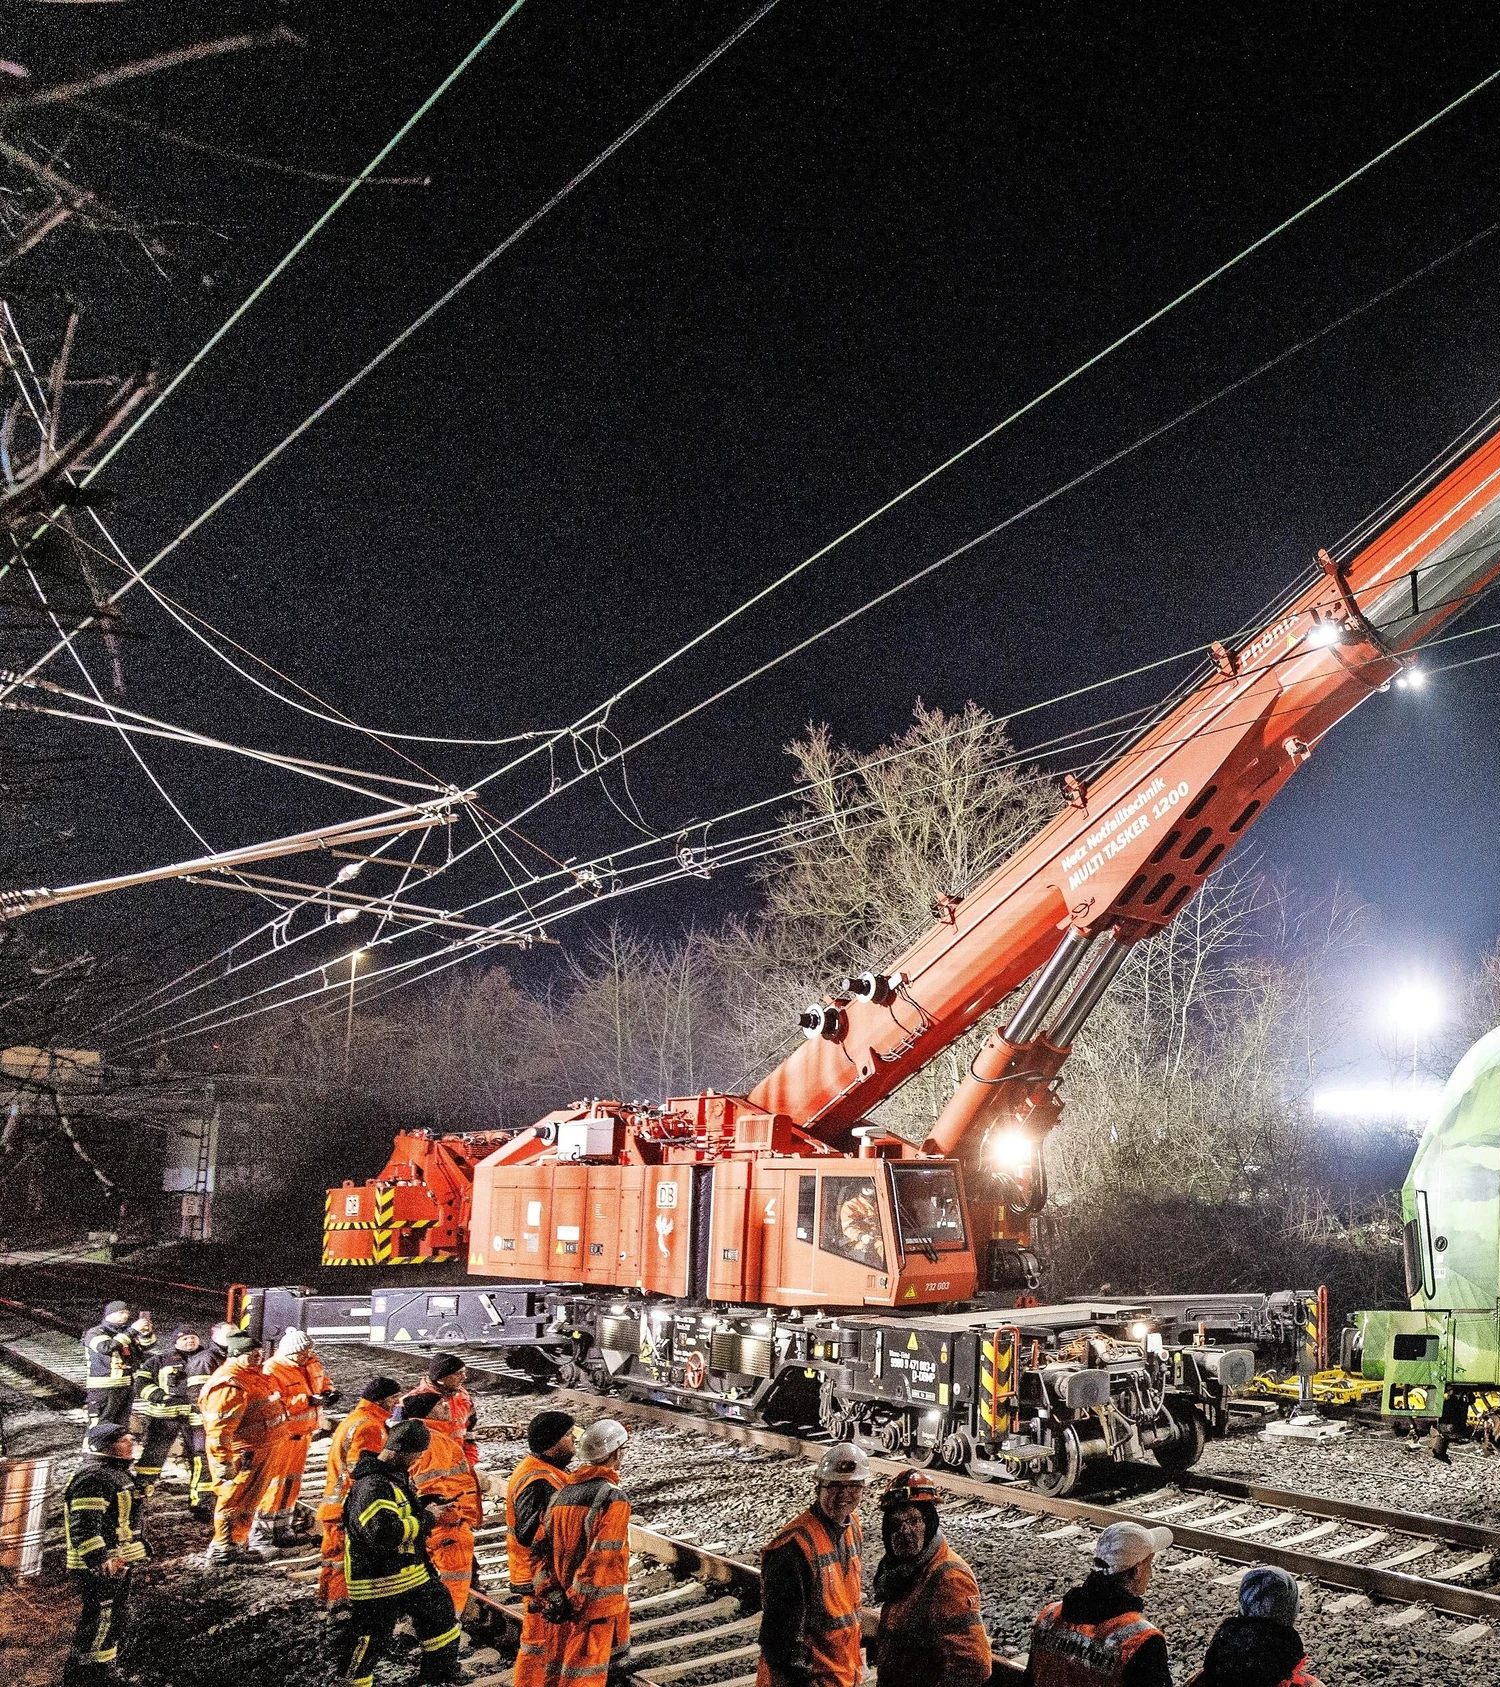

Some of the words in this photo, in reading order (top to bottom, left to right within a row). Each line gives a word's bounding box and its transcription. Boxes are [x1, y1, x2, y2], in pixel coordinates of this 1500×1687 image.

[1061, 845, 1088, 873] Netz
[1086, 777, 1166, 850] Notfalltechnik
[1068, 852, 1105, 891] MULTI
[1102, 814, 1150, 860] TASKER
[1152, 781, 1189, 820] 1200
[659, 1187, 674, 1203] DB
